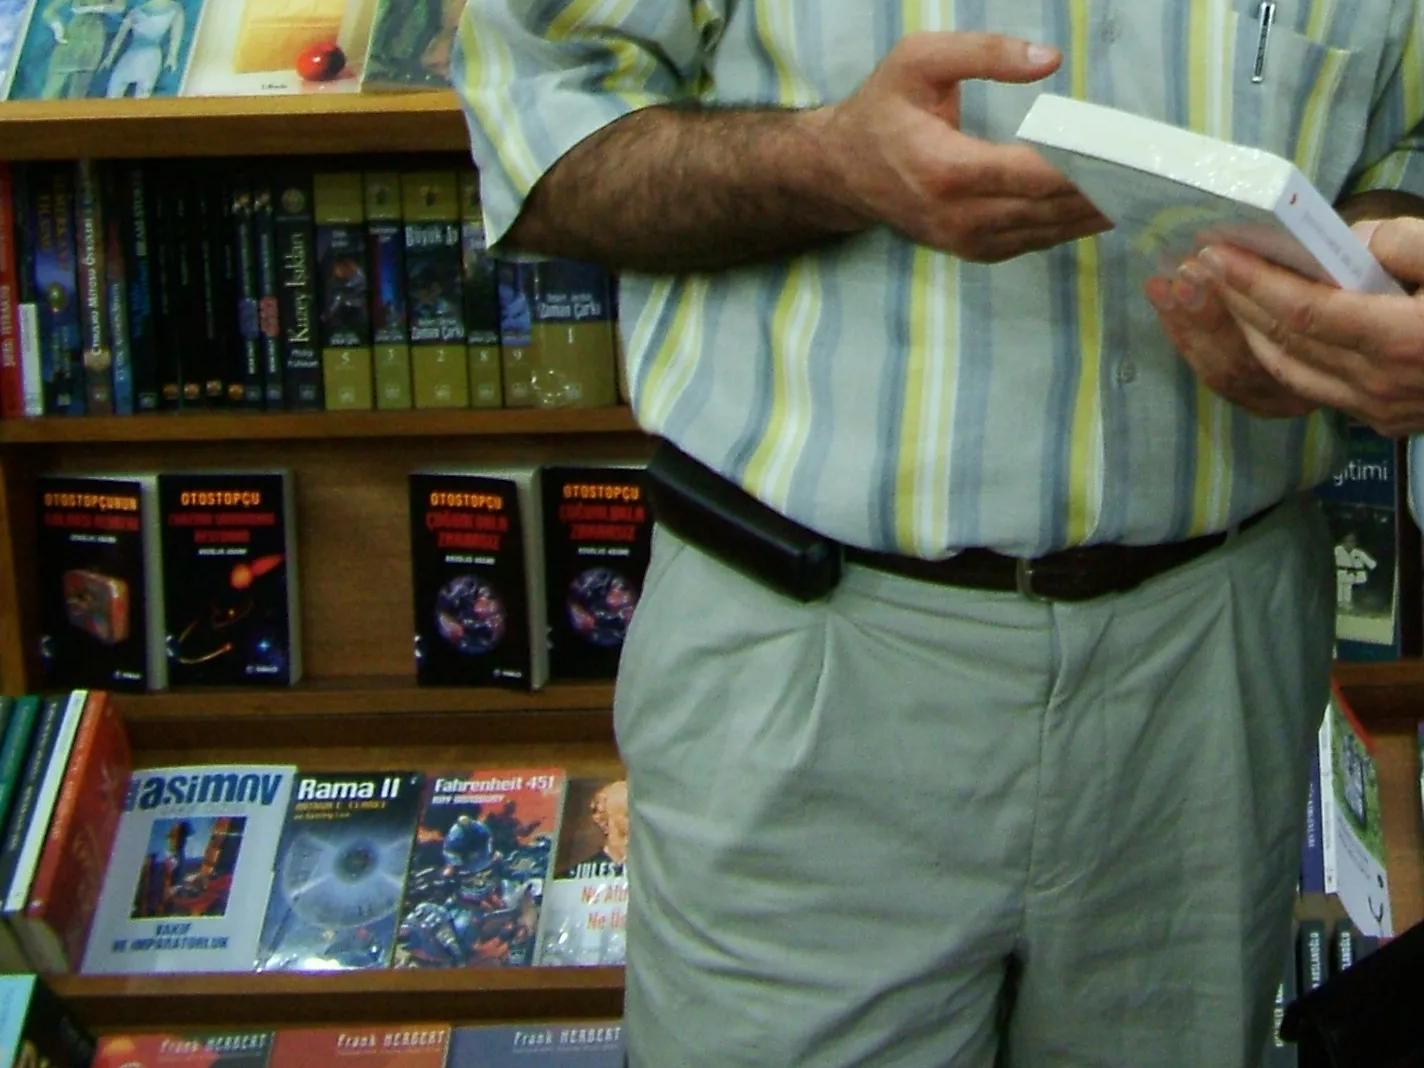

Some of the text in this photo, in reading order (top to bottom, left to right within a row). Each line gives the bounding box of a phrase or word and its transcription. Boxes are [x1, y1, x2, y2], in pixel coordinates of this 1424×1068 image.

[287, 293, 311, 343] Kuzey
[540, 303, 574, 319] Zaman
[437, 349, 444, 362] 2
[180, 490, 261, 509] OTOSTOPÇU
[429, 491, 504, 512] OTOSTOPÇU
[562, 483, 641, 502] OTOSTOPÇU
[139, 772, 284, 811] asimov
[297, 777, 401, 800] Rama II
[434, 775, 557, 793] Fahrenheit 451
[574, 862, 616, 879] JULES
[160, 1034, 267, 1054] Frank HERBERT
[337, 1029, 445, 1049] Frank HERBERT
[513, 1027, 621, 1046] Frank HERBERT
